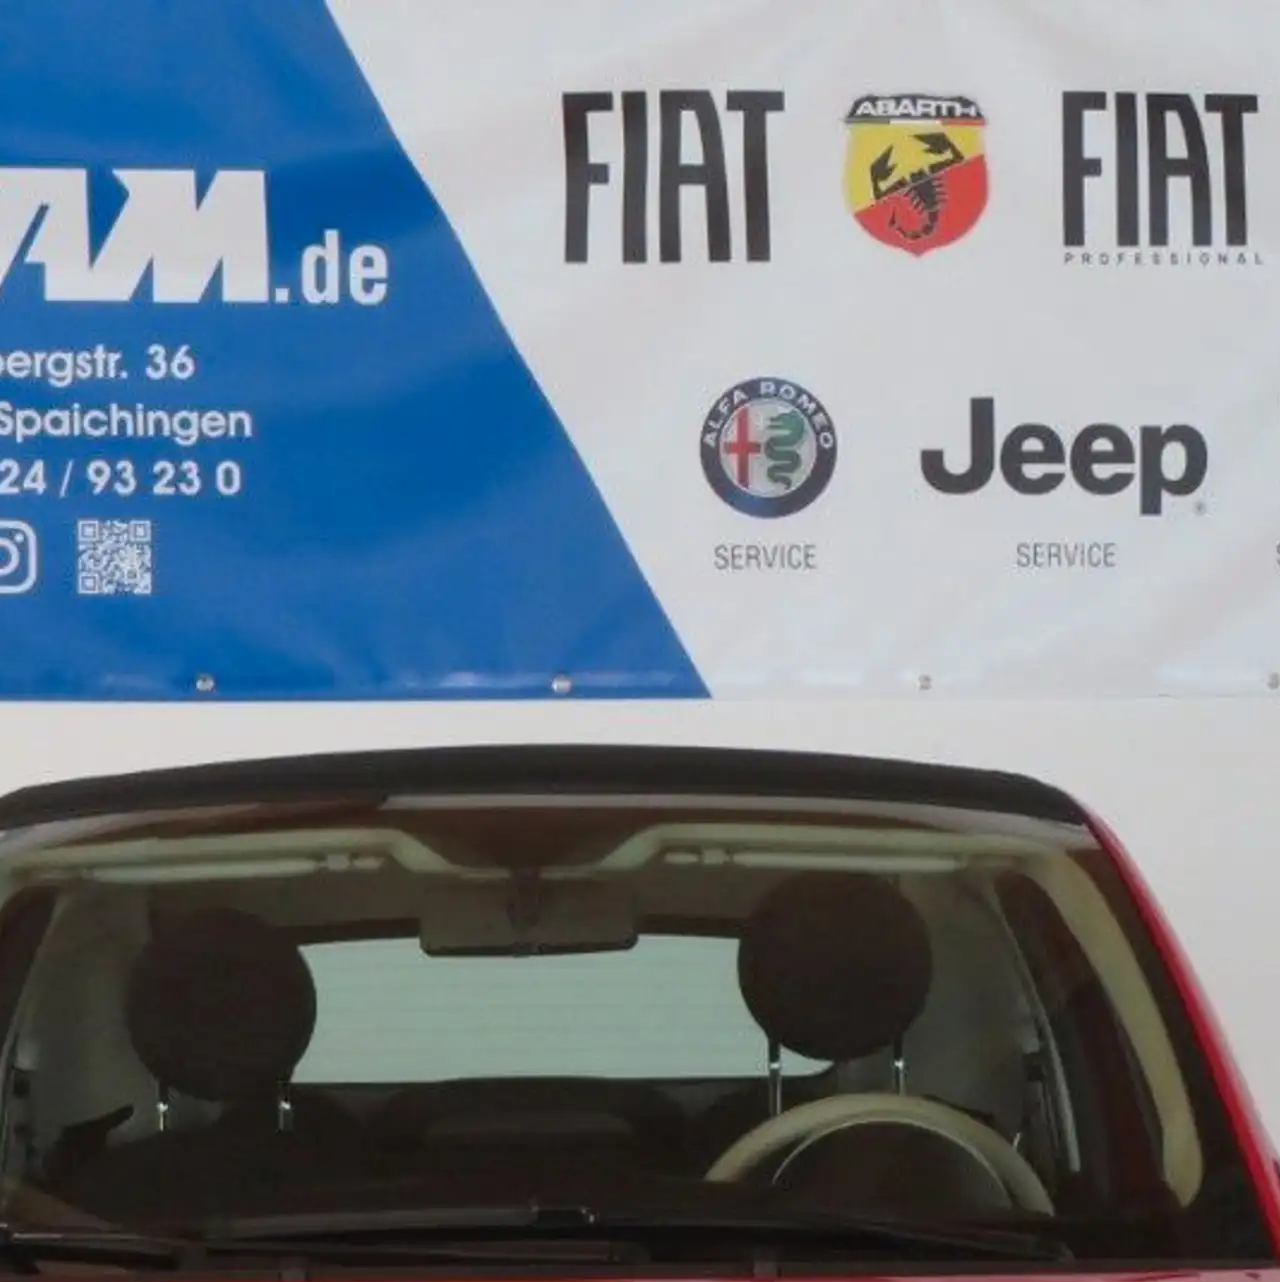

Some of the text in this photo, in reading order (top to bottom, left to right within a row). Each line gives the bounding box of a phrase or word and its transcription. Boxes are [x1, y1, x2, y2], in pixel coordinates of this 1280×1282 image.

[855, 98, 977, 117] ABARTH
[562, 89, 785, 264] FIAT
[1062, 91, 1258, 247] FIAT
[1064, 252, 1264, 266] PROFESSIONAL
[145, 343, 196, 380] 36
[703, 380, 834, 449] ALFA ROMEO
[920, 396, 1208, 515] Jeep
[86, 459, 137, 496] 93
[152, 460, 201, 496] 23
[215, 460, 241, 496] 0
[713, 544, 817, 570] SERVICE
[1015, 542, 1117, 568] SERVICE
